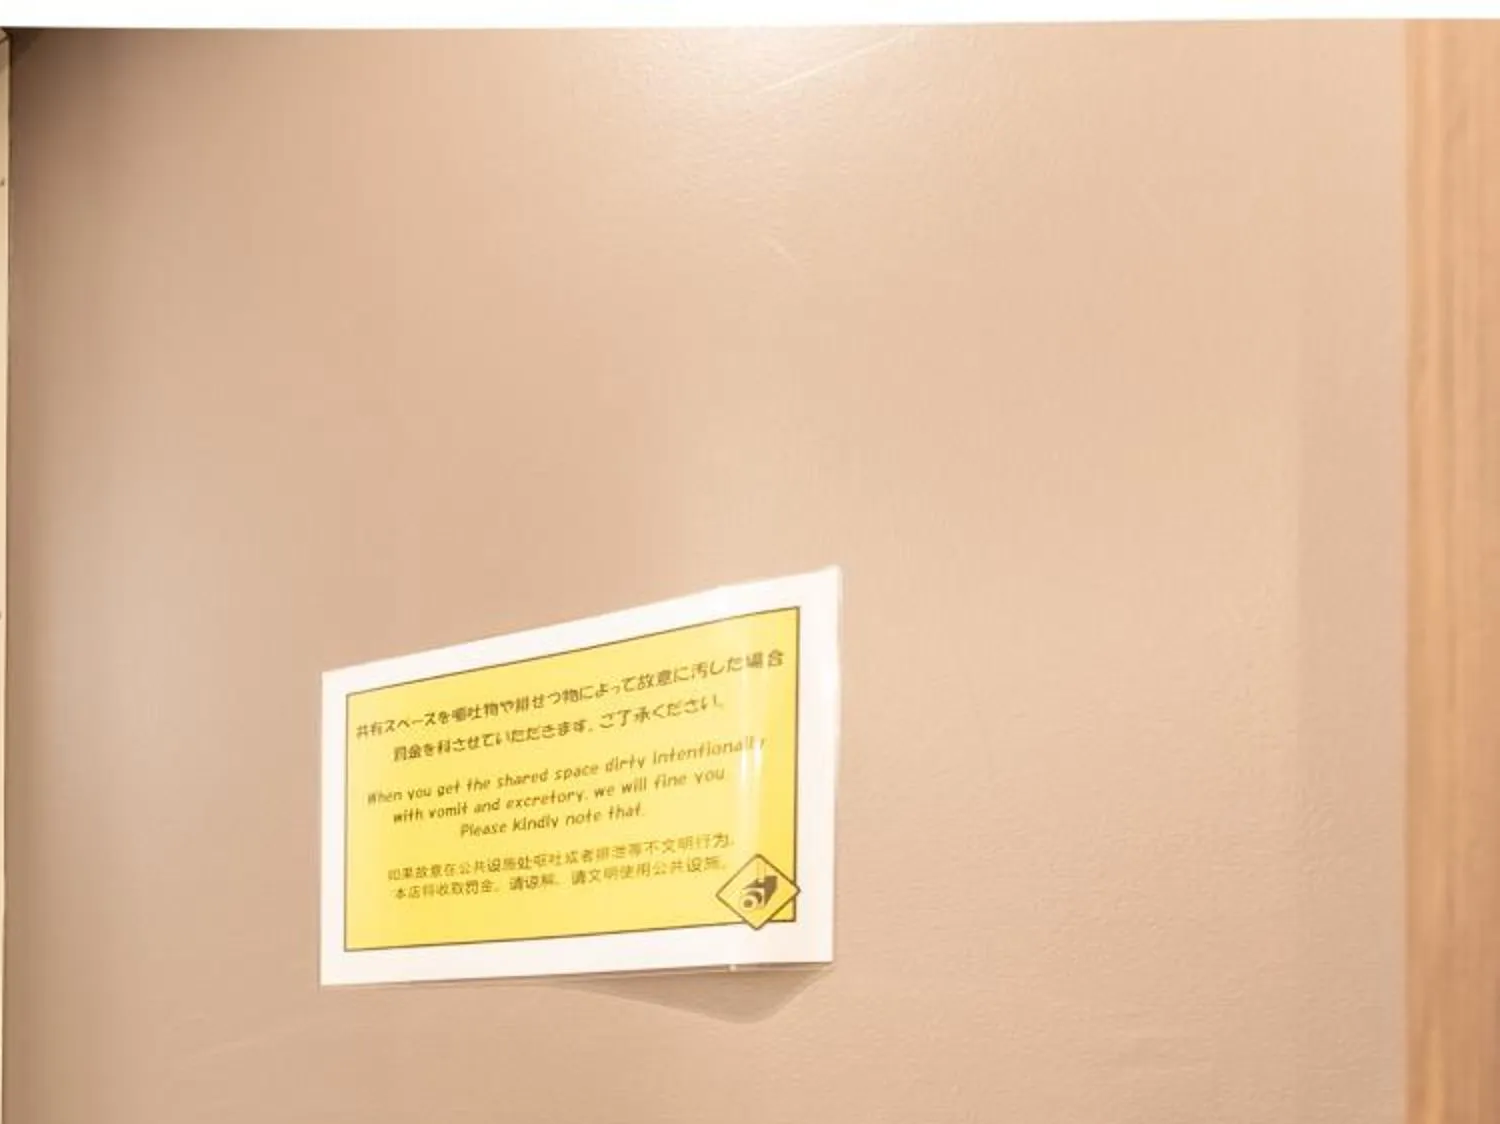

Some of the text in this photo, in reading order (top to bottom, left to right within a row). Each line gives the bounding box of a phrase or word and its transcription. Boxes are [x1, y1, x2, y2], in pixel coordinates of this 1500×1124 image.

[367, 789, 403, 806] When
[407, 786, 431, 802] you
[436, 779, 460, 798] get
[466, 777, 491, 793] the
[497, 768, 549, 789] shared
[554, 762, 599, 784] space
[605, 754, 646, 774] dirty
[393, 807, 423, 824] with
[428, 801, 468, 819] vomit
[473, 798, 501, 814] and
[593, 785, 616, 799] we
[621, 776, 648, 794] will
[653, 772, 688, 791] fine
[460, 820, 508, 838] Please
[511, 813, 560, 833] kindly
[565, 807, 602, 827] note
